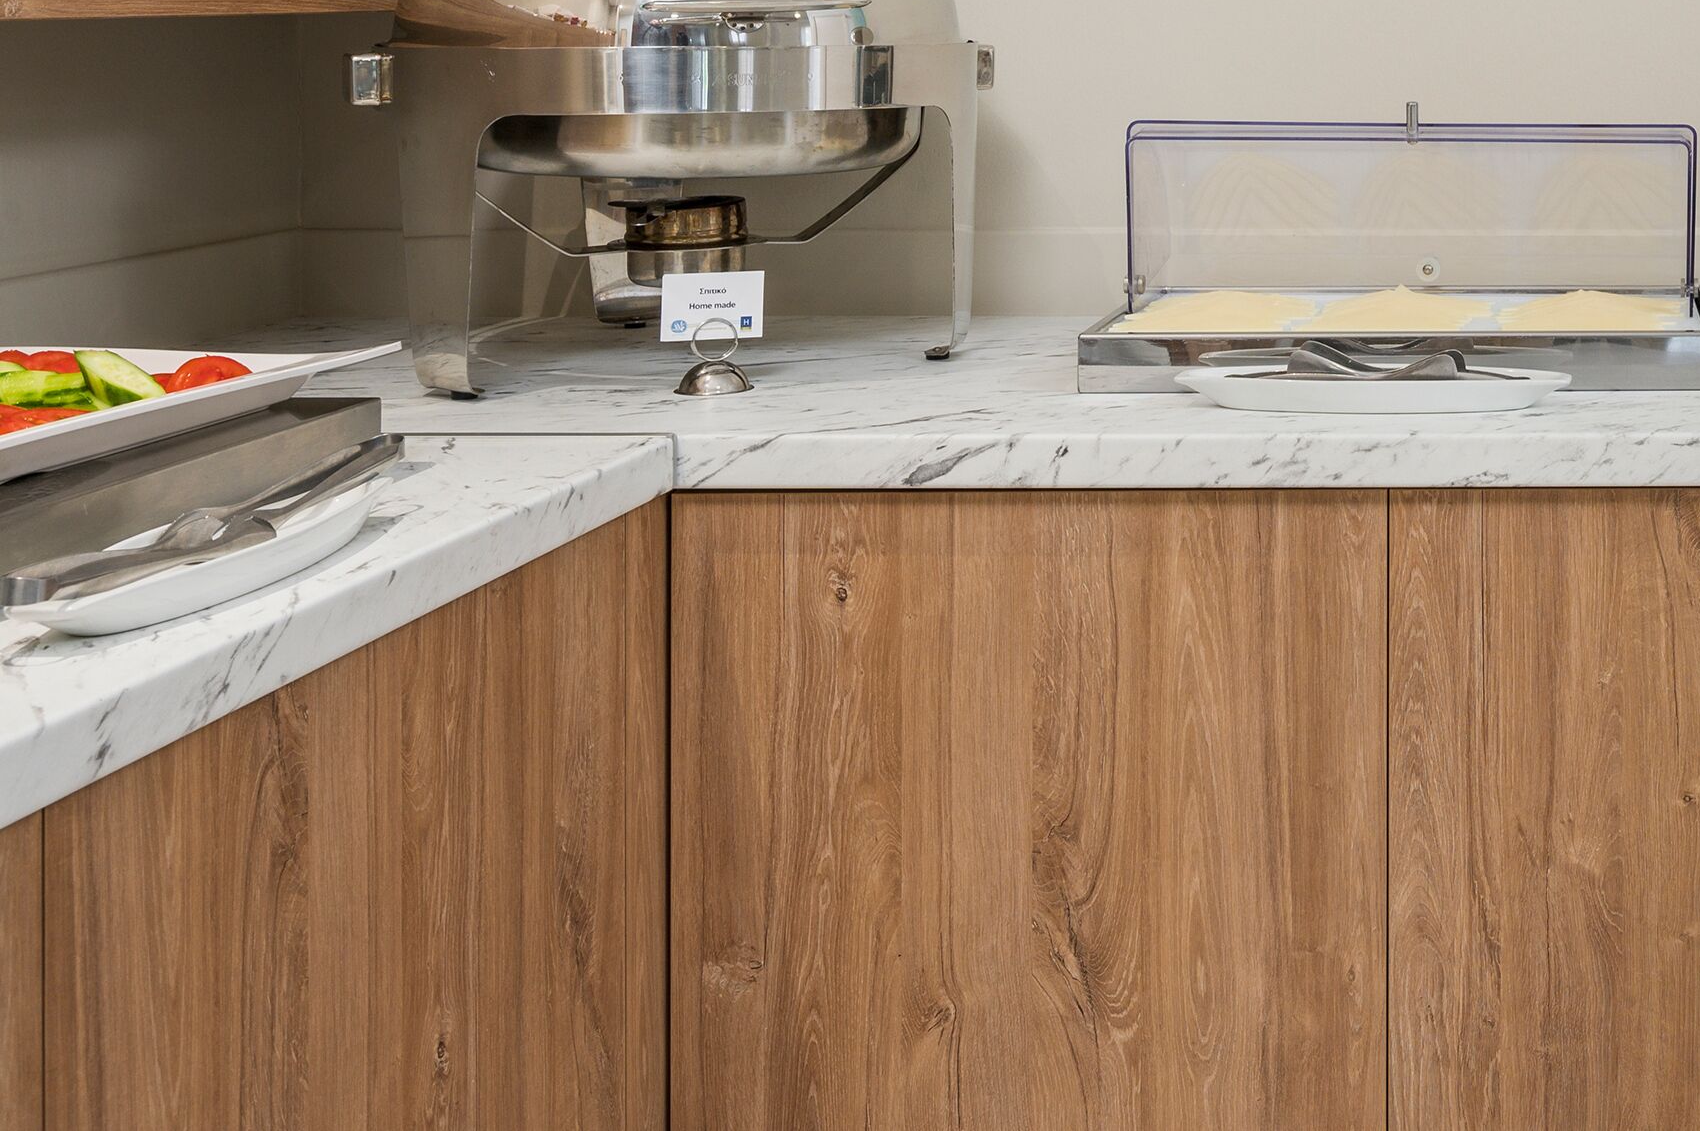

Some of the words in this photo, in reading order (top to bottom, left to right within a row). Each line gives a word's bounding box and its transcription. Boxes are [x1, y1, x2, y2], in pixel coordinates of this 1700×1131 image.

[699, 287, 727, 295] Σπιτικό
[689, 302, 712, 310] Home
[714, 301, 736, 309] made
